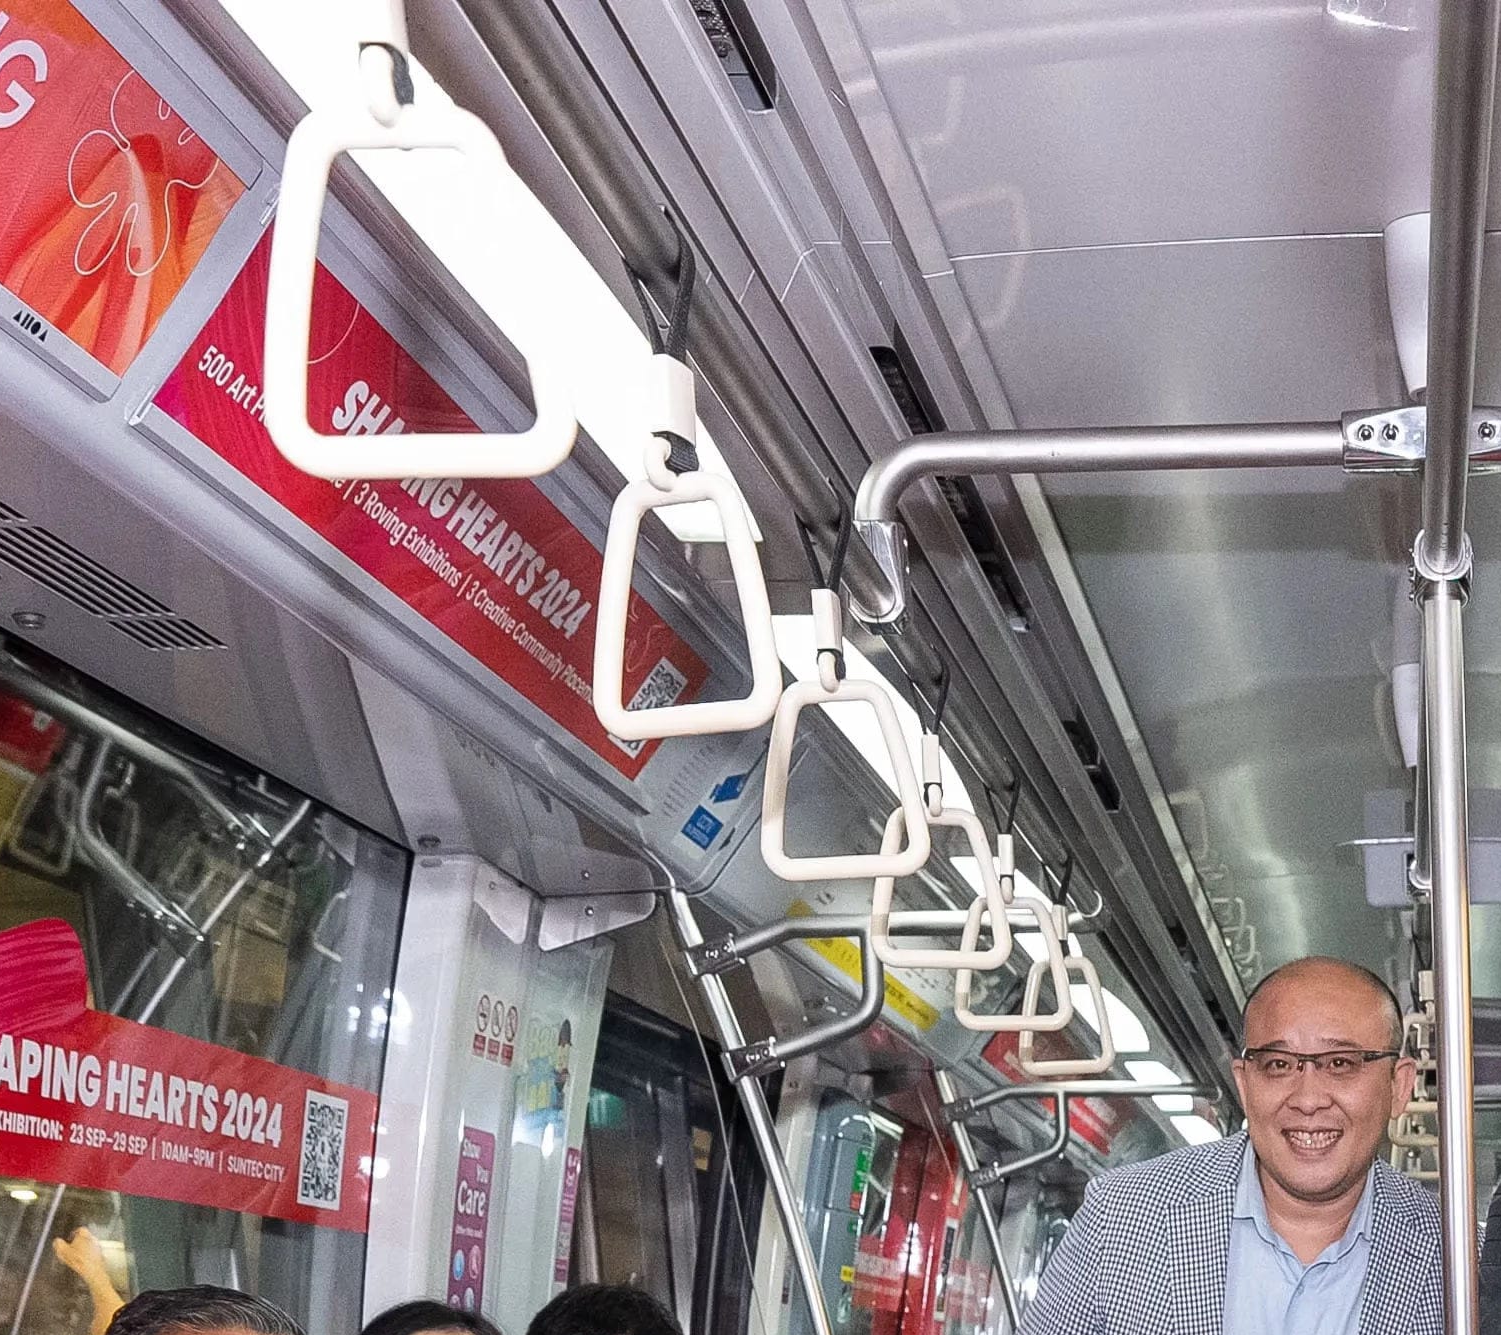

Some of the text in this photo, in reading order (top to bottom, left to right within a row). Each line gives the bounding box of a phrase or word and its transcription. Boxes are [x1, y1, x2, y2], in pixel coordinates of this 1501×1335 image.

[198, 345, 258, 410] 500 Art
[353, 482, 594, 702] 3 Roving Exhibitions 3 Creative Community Placem
[446, 490, 546, 597] HEARTS
[527, 568, 592, 640] 2024
[105, 1059, 218, 1134] HEARTS
[220, 1088, 284, 1148] 2024
[69, 1123, 84, 1144] 23
[128, 1137, 148, 1156] SEP
[226, 1155, 263, 1178] SUNTEC
[263, 1162, 285, 1183] CITY
[457, 1179, 487, 1217] Care
